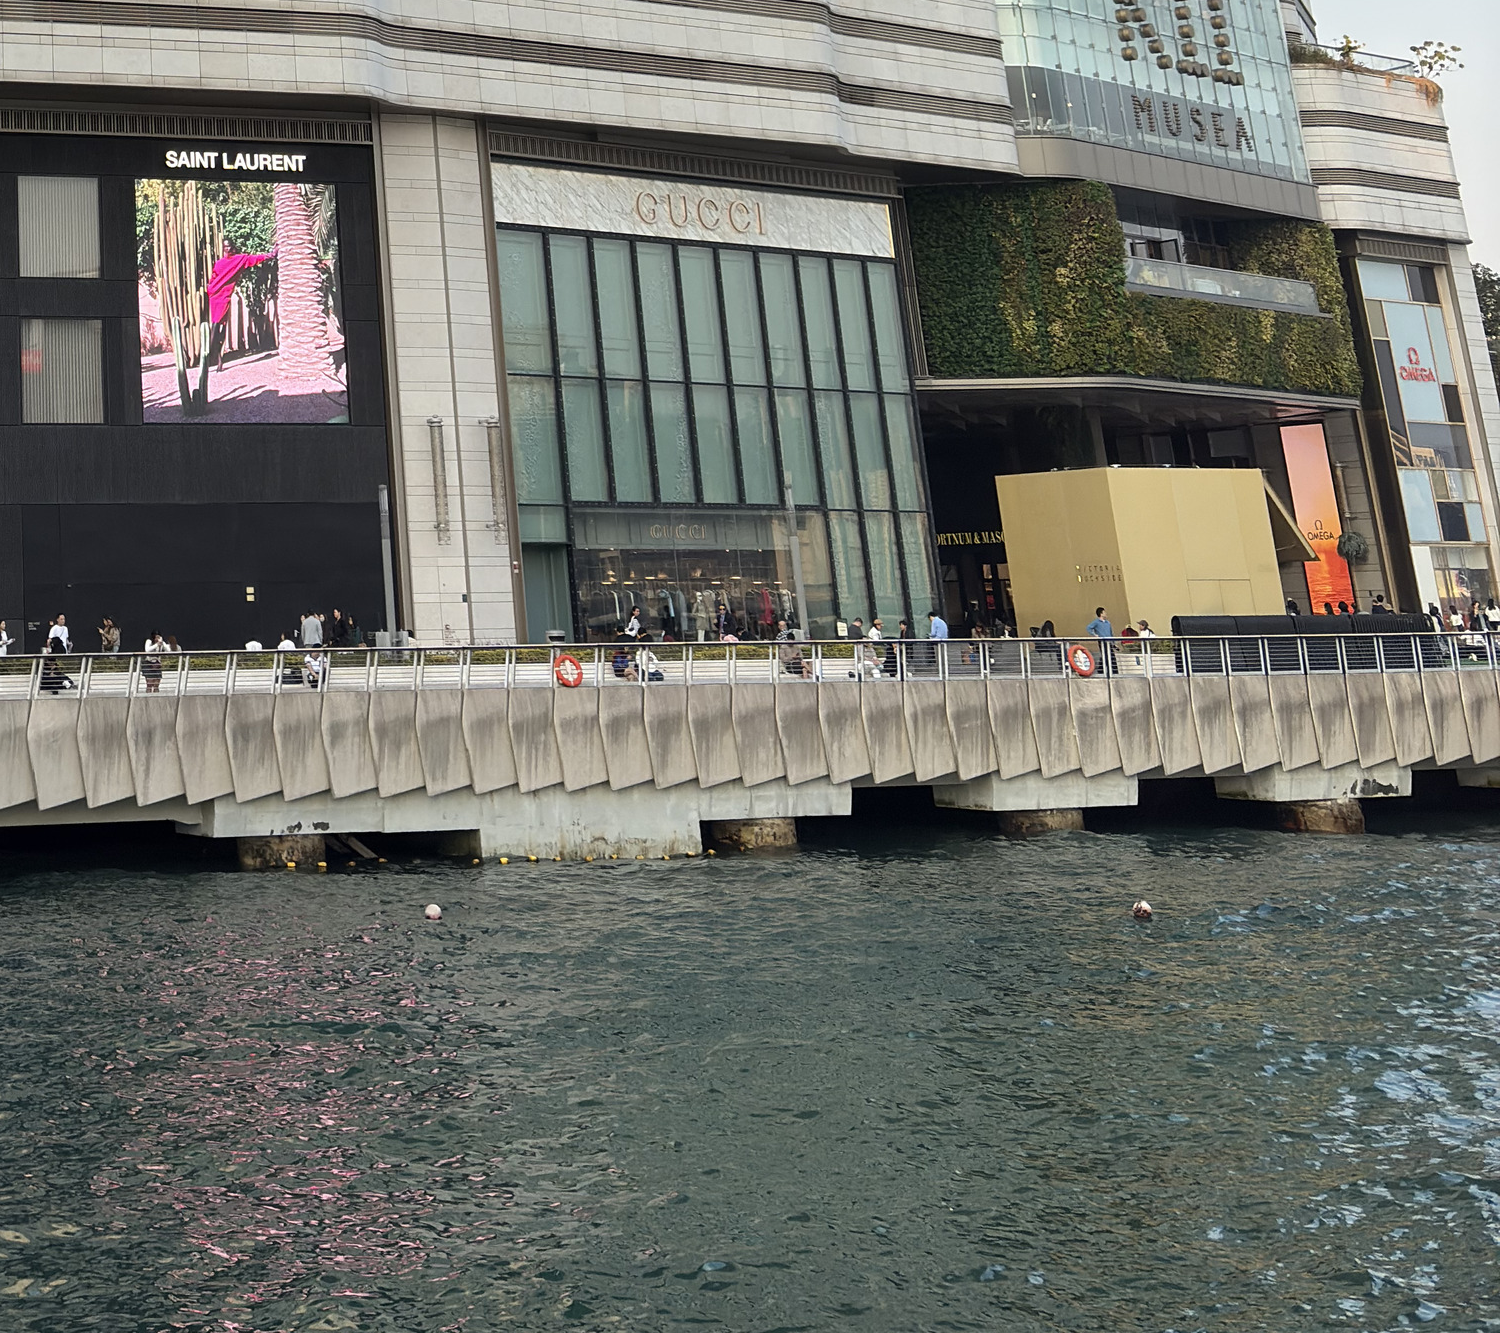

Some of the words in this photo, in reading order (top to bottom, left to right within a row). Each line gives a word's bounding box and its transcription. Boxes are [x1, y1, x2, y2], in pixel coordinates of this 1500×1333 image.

[1131, 95, 1254, 152] MUSEA
[165, 150, 219, 169] SAINT
[222, 153, 307, 172] LAURENT
[636, 191, 766, 235] GUCCI
[1399, 366, 1436, 382] OMEGA
[650, 524, 707, 540] GUCCI
[936, 532, 973, 545] ORTNUM
[974, 531, 981, 544] &
[982, 530, 1006, 544] MASO
[1307, 532, 1334, 540] OMEGA
